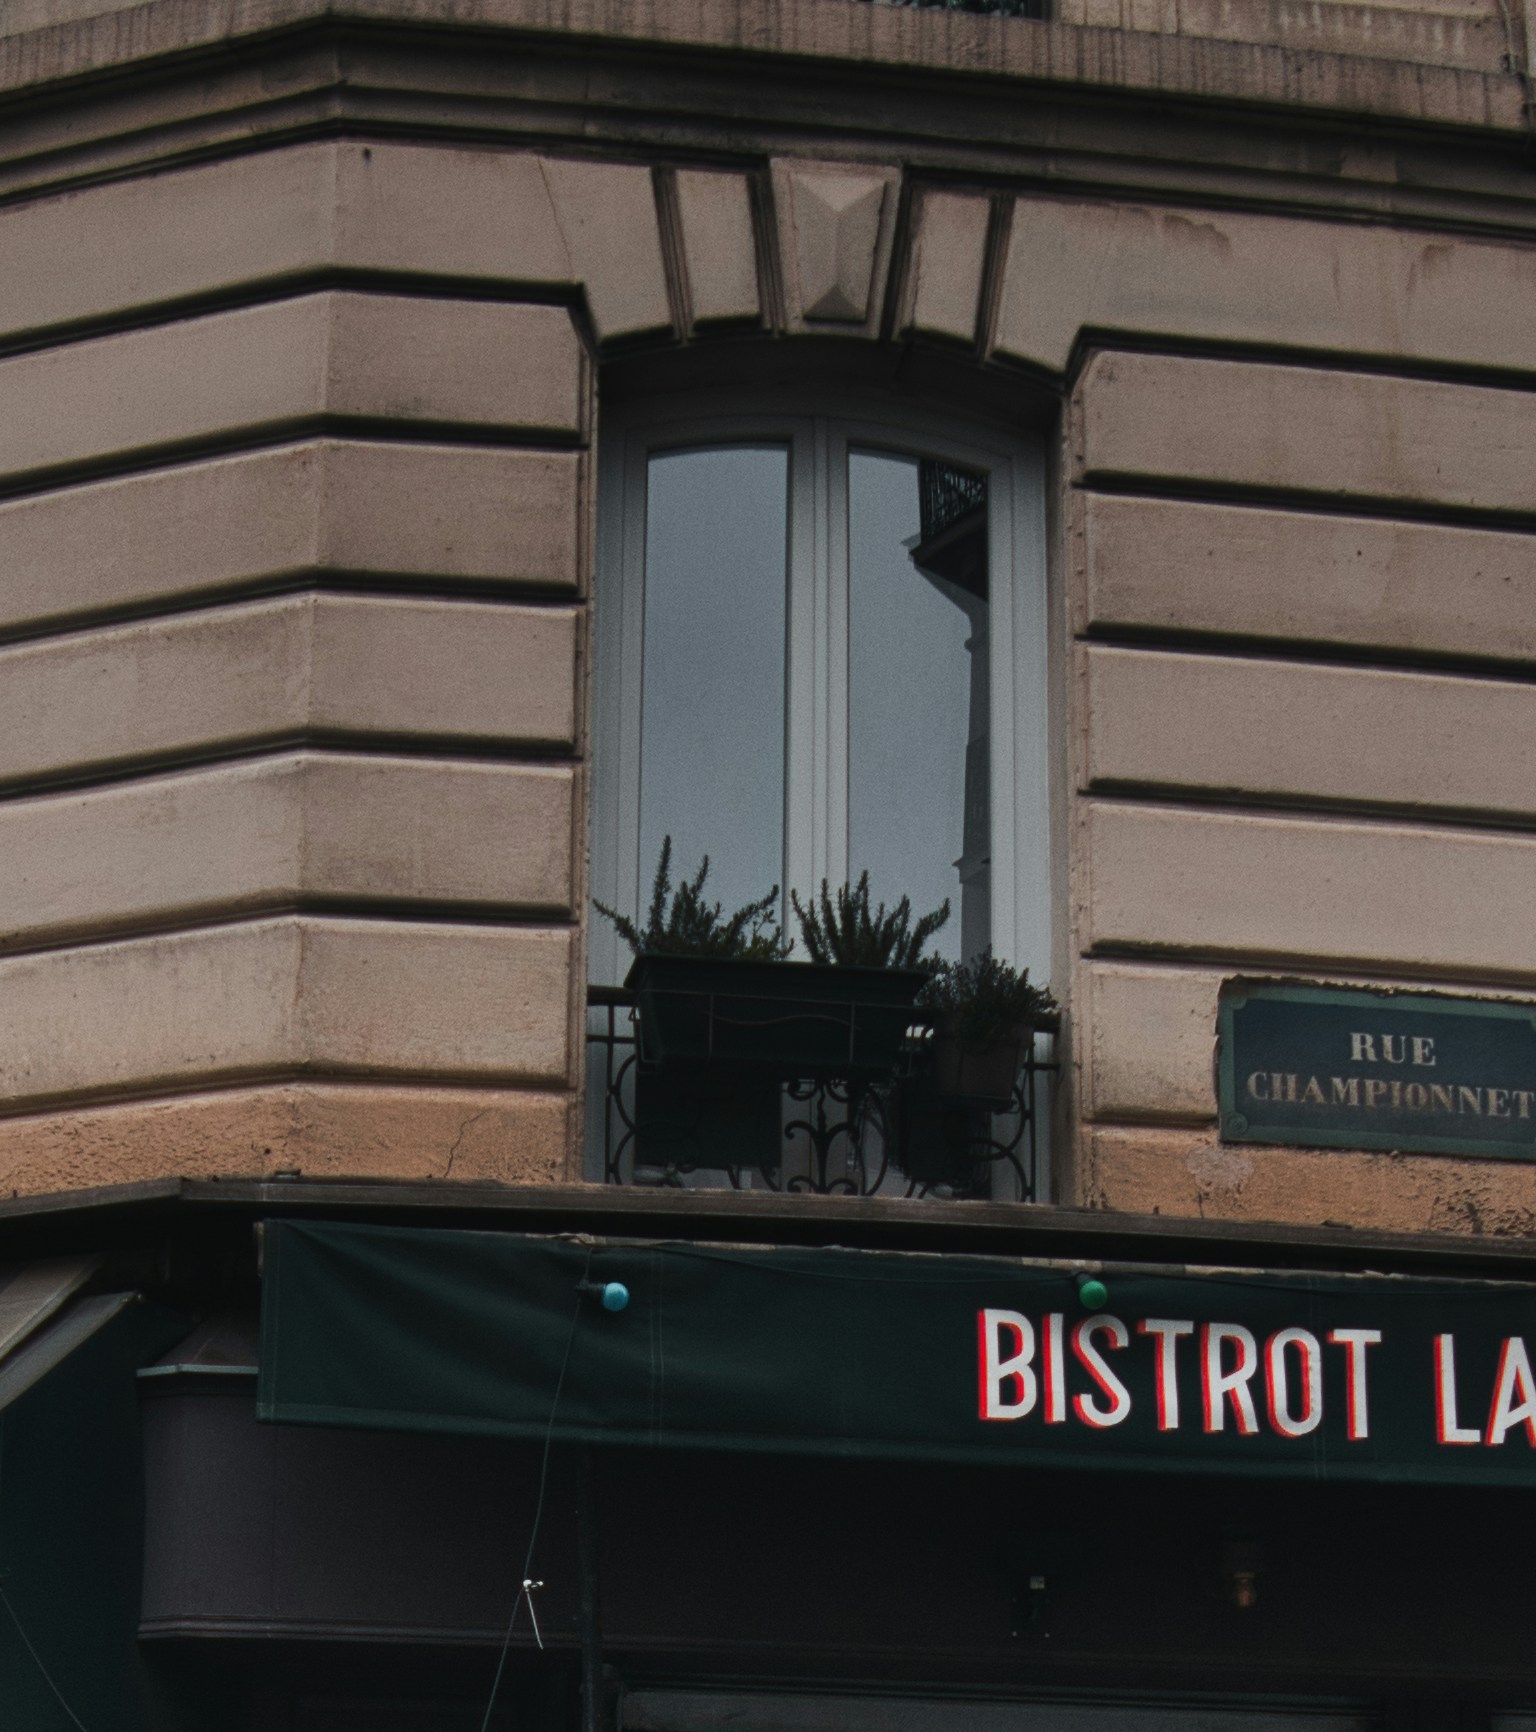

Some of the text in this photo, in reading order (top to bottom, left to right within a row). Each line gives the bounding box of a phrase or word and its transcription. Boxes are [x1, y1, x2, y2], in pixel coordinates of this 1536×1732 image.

[1349, 1031, 1437, 1066] RUE
[1246, 1072, 1536, 1119] CHAMPIONNET
[977, 1308, 1382, 1440] BISTROT
